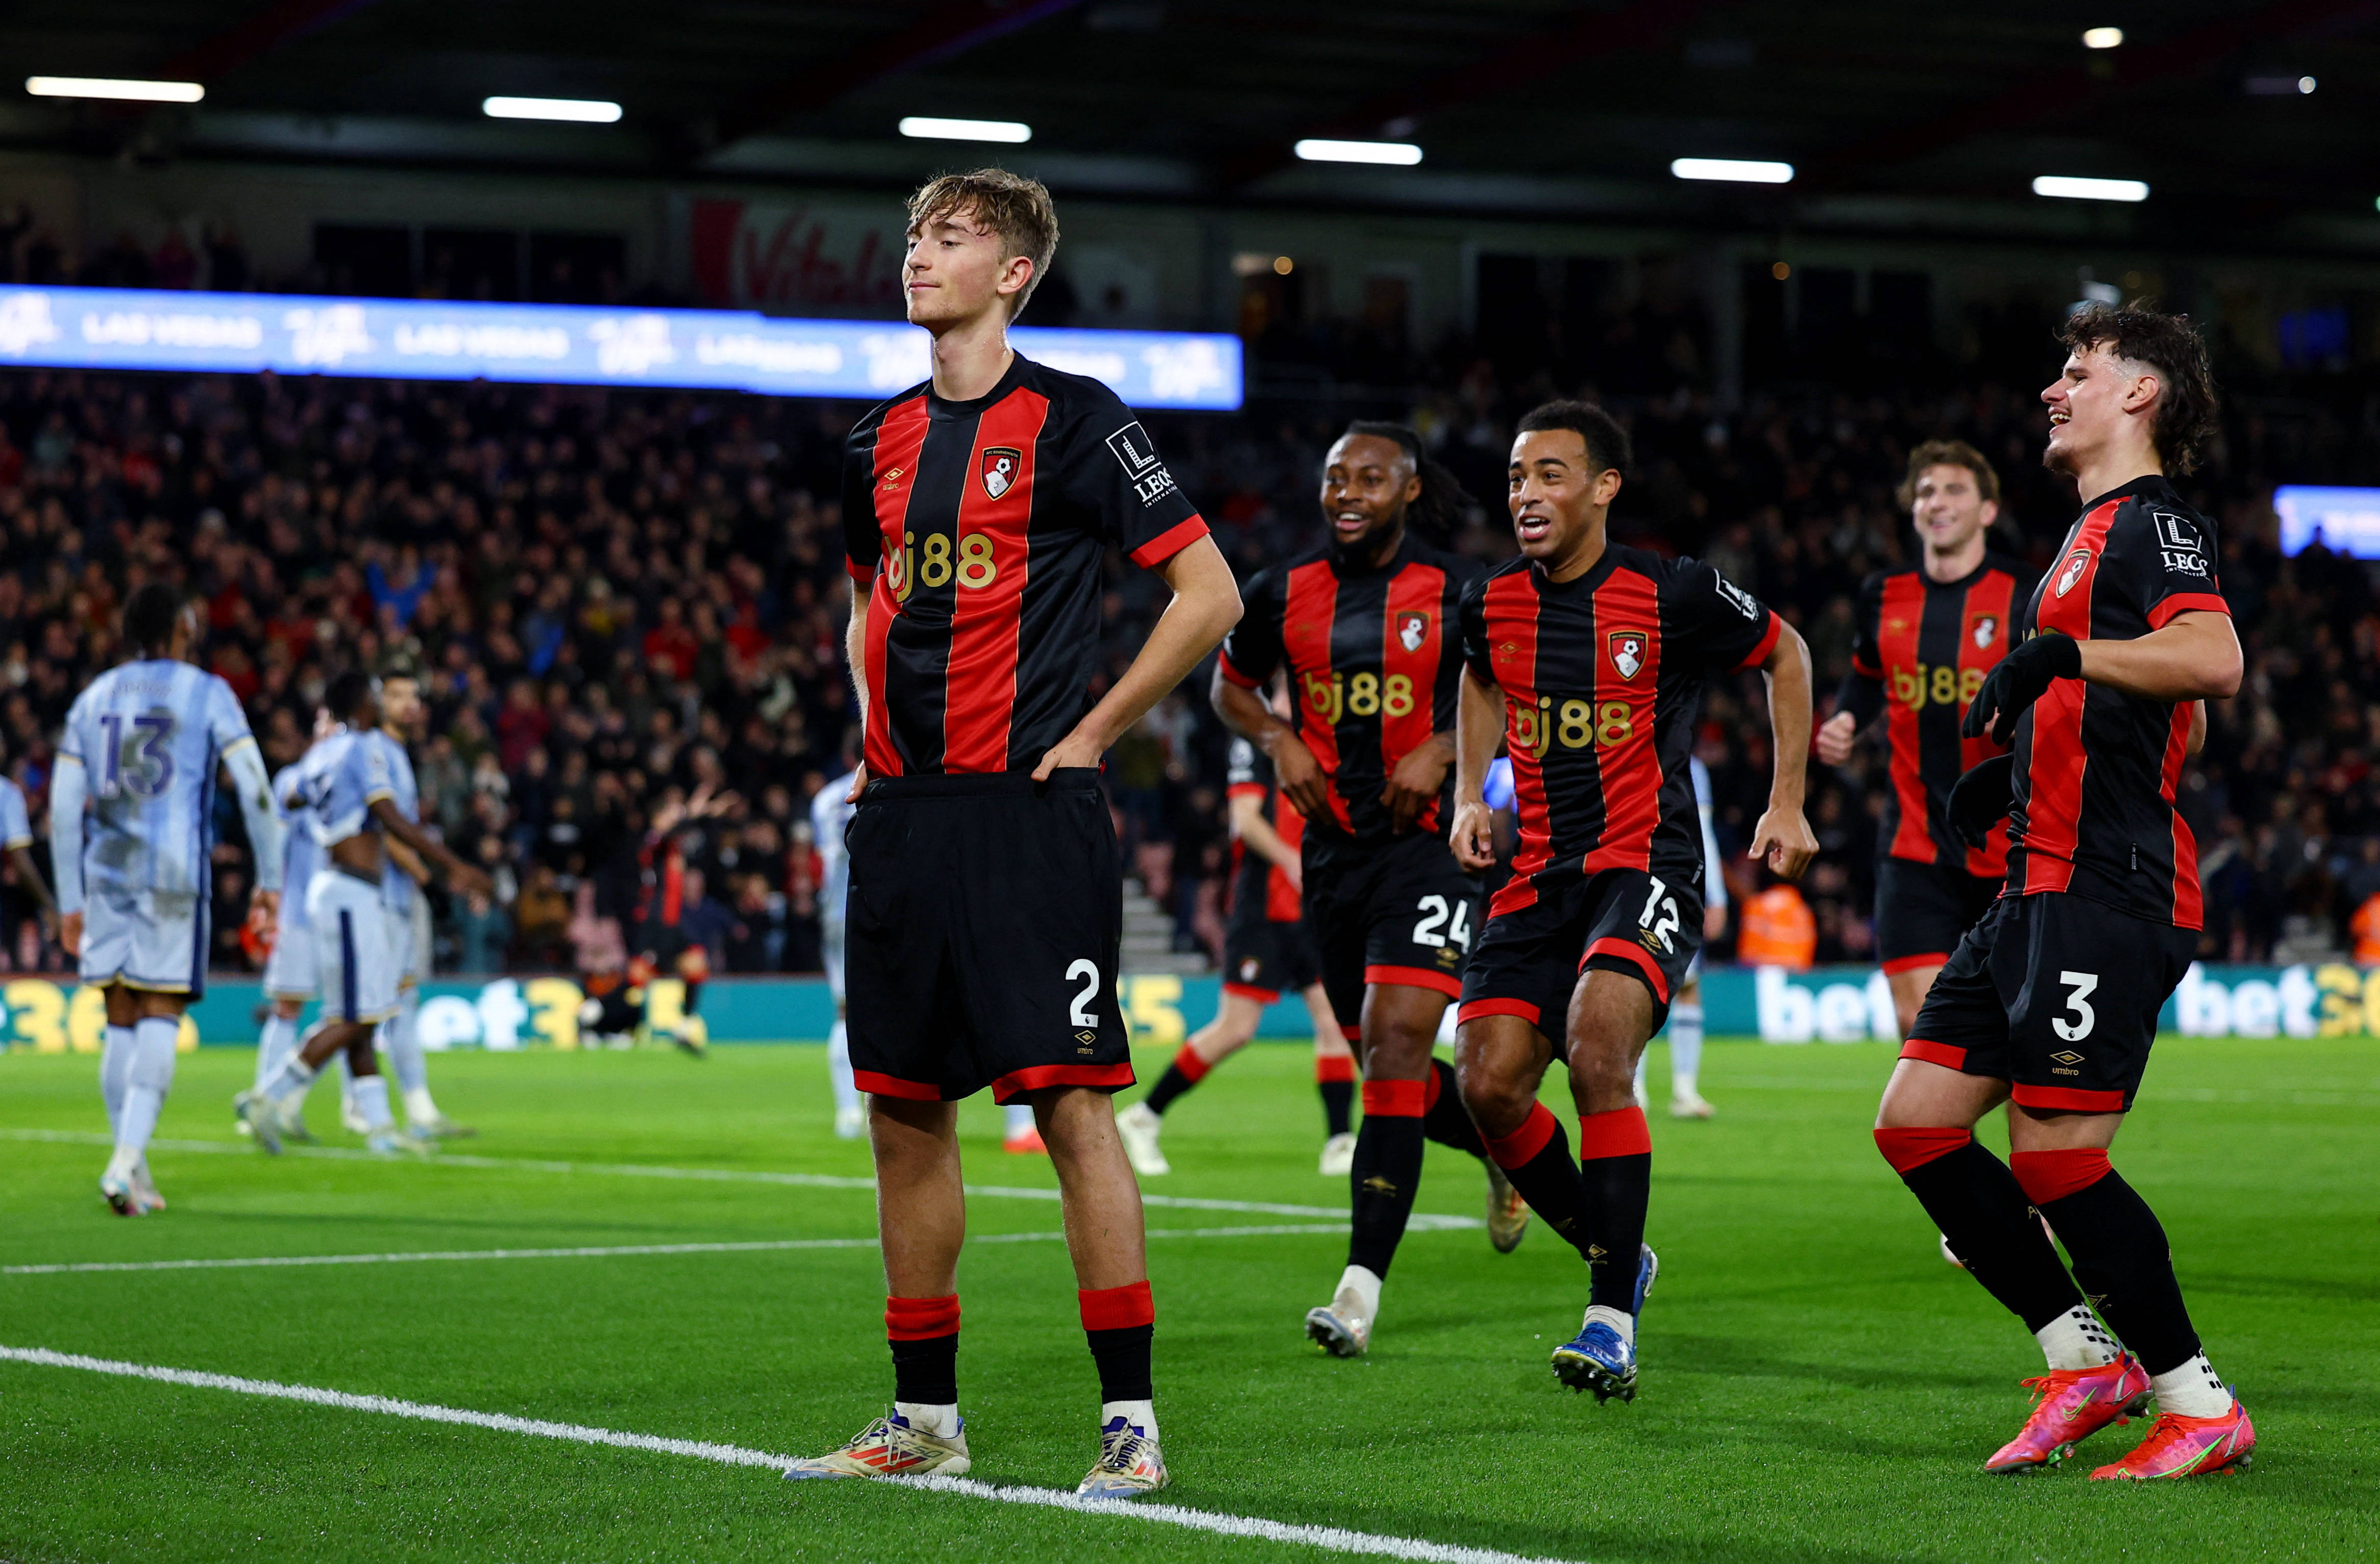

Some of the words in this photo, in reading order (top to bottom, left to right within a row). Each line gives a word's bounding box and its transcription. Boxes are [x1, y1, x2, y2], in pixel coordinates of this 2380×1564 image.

[1134, 467, 1174, 502] LEOS
[884, 531, 997, 602] bj88
[1305, 671, 1414, 725] bj88
[1511, 697, 1633, 758] bj88
[101, 715, 176, 800] 13
[1412, 894, 1471, 955] 24
[1638, 875, 1680, 955] 12
[1066, 958, 1099, 1027] 2
[2052, 971, 2098, 1041] 3
[2053, 1067, 2079, 1076] umbro
